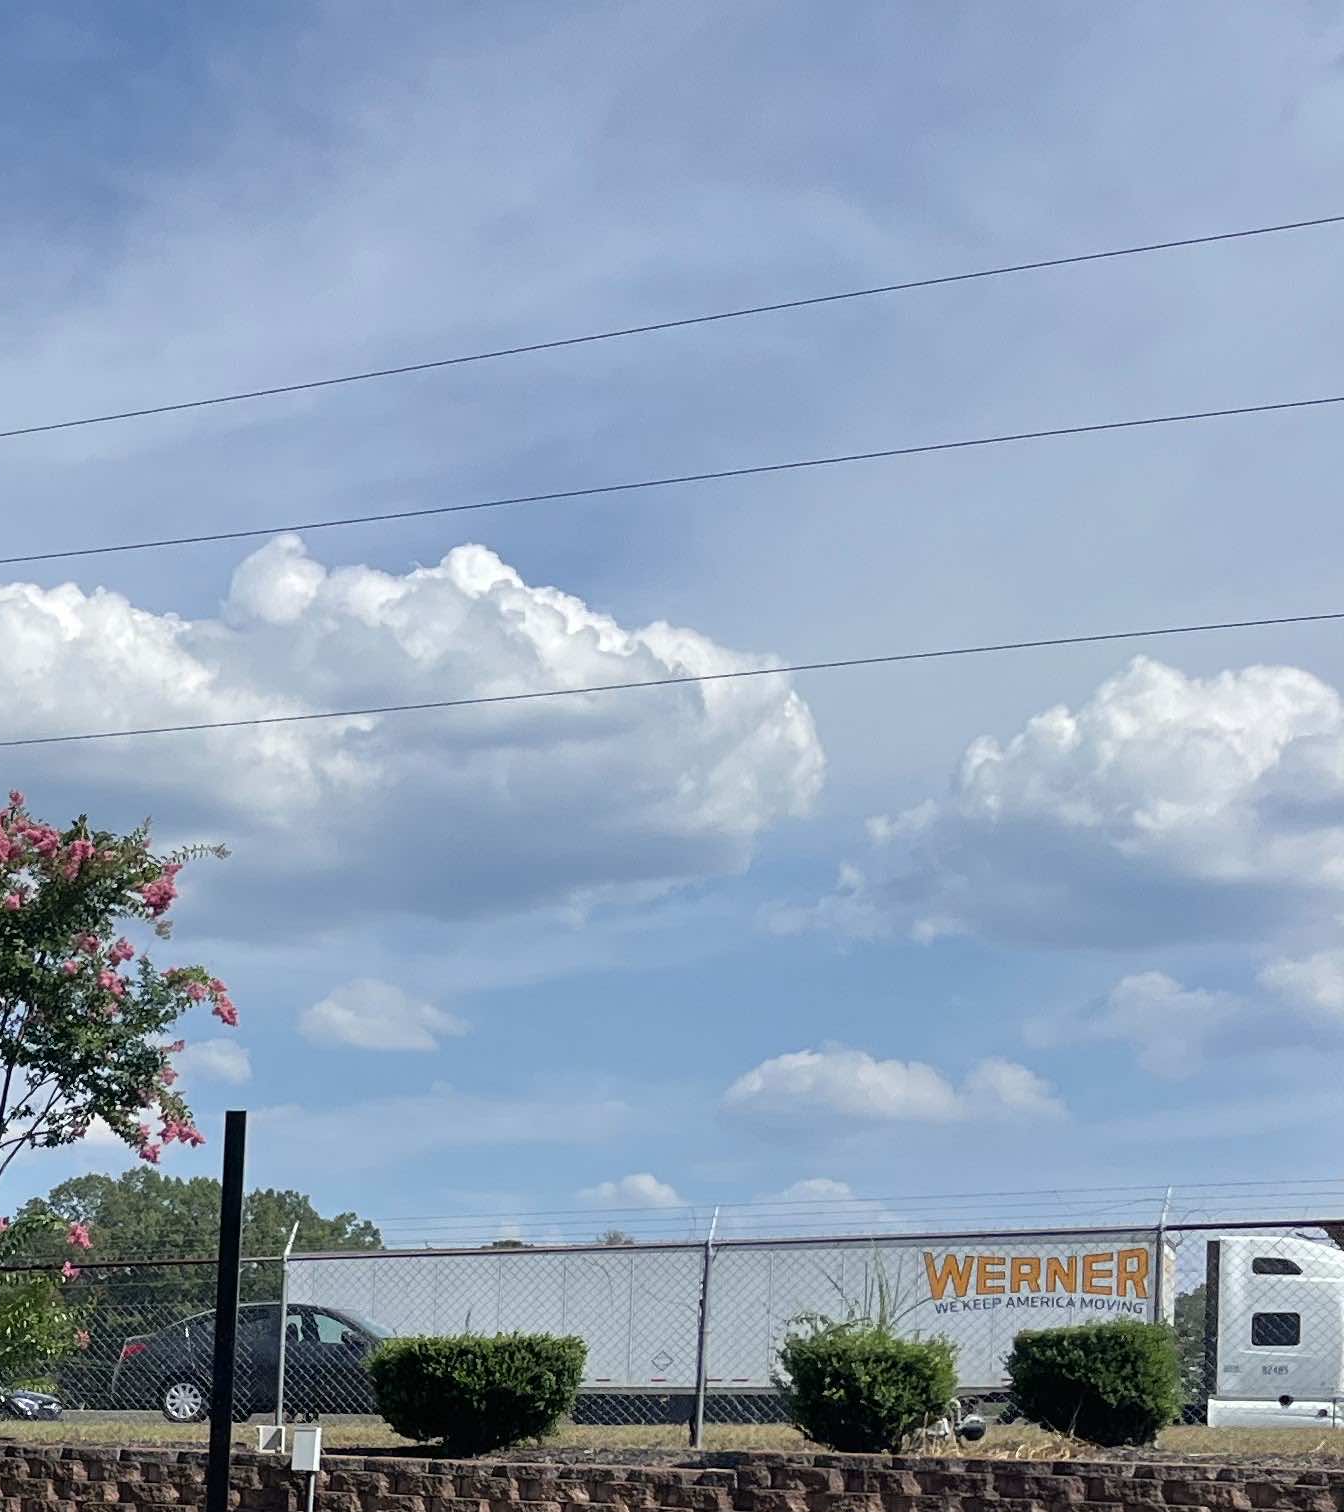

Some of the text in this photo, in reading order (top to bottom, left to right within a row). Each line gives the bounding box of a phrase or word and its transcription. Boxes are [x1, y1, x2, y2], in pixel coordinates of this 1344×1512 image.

[924, 1248, 1150, 1300] WERNER
[934, 1296, 1145, 1315] WE KEEP AMERICA MOVING
